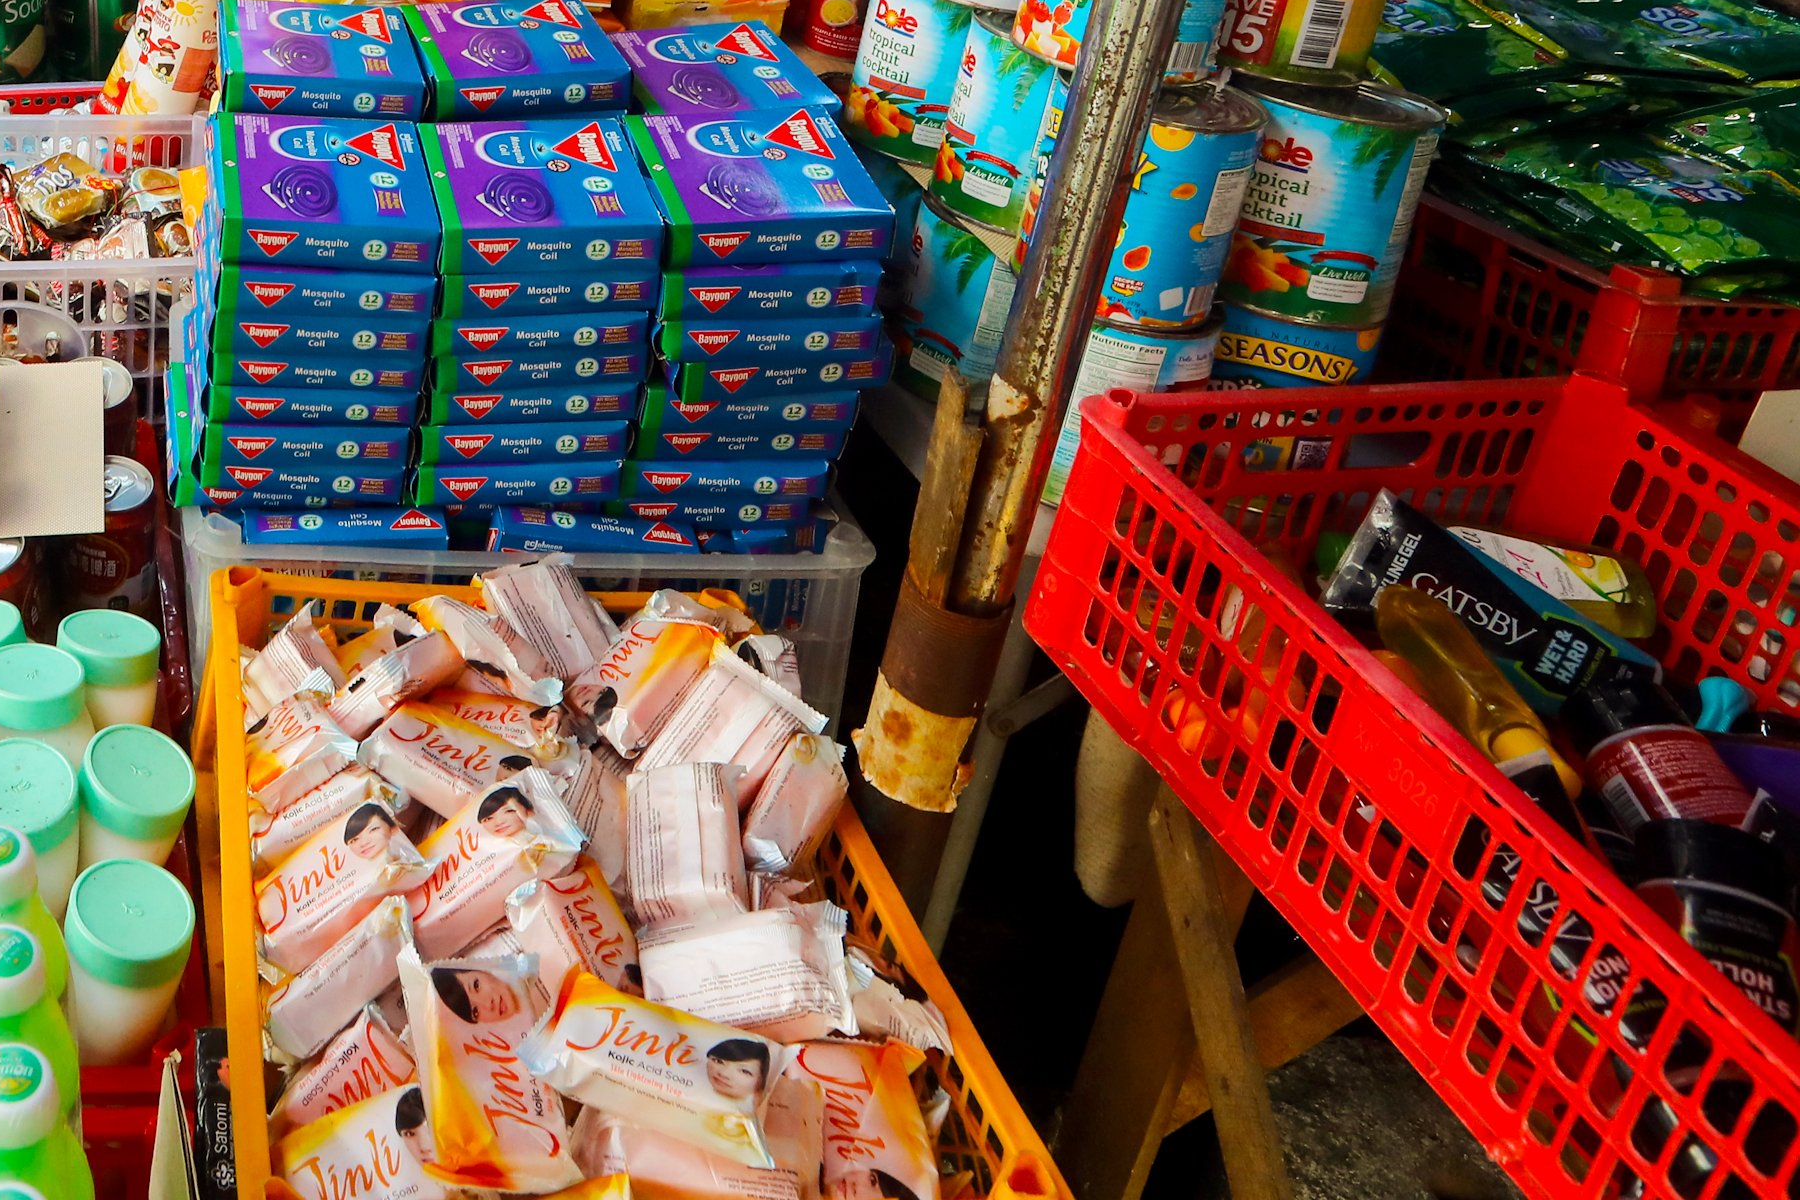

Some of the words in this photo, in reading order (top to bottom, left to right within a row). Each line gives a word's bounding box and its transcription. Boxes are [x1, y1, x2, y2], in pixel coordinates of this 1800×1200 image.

[869, 26, 916, 57] tropical
[871, 44, 900, 67] fruit
[862, 53, 910, 85] cocktail
[258, 87, 289, 100] Baygon
[302, 91, 342, 102] Mosquito
[312, 101, 329, 110] Coil
[358, 96, 372, 106] 12
[371, 130, 398, 162] Baygon
[786, 118, 824, 152] Baygon
[257, 232, 291, 247] Baygon
[305, 237, 350, 249] Mosquito
[317, 247, 336, 257] Coil
[367, 243, 382, 254] 12
[708, 236, 742, 249] Baygon
[757, 232, 802, 245] Mosquito
[769, 242, 788, 252] Coil
[819, 234, 836, 246] 12
[1318, 266, 1342, 280] Live
[254, 284, 287, 298] Baygon
[302, 288, 346, 301] Mosquito
[363, 294, 379, 305] 12
[699, 290, 734, 302] Baygon
[748, 289, 792, 300] Mosquito
[760, 299, 778, 309] Coil
[810, 292, 826, 302] 12
[1091, 332, 1134, 352] Nutrition
[1137, 343, 1166, 357] Facts
[1219, 335, 1347, 381] SEASONS
[234, 469, 266, 481] Baygon
[279, 473, 320, 484] Mosquito
[652, 475, 684, 487] Baygon
[698, 477, 740, 488] Mosquito
[338, 518, 382, 528] Mosquito
[1400, 533, 1422, 558] GEL
[1411, 572, 1538, 645] GATSBY
[1535, 639, 1562, 676] WET
[1555, 630, 1573, 642] &
[1554, 637, 1589, 684] HARD
[389, 717, 492, 771] Jinli
[282, 806, 304, 822] Kojic
[304, 795, 323, 810] Acid
[323, 785, 345, 801] Soap
[438, 883, 457, 901] Kojic
[474, 852, 496, 868] Soap
[255, 845, 346, 935] Jinli
[296, 896, 316, 914] Kojic
[335, 869, 357, 886] Soap
[540, 871, 625, 967] Jinli
[564, 905, 580, 932] Kojic
[565, 1007, 698, 1066] Jinli
[608, 1050, 635, 1066] Kojic
[637, 1062, 662, 1076] Acid
[666, 1070, 694, 1088] Soap
[464, 1030, 560, 1159] Jinli
[214, 1102, 228, 1155] Satomi
